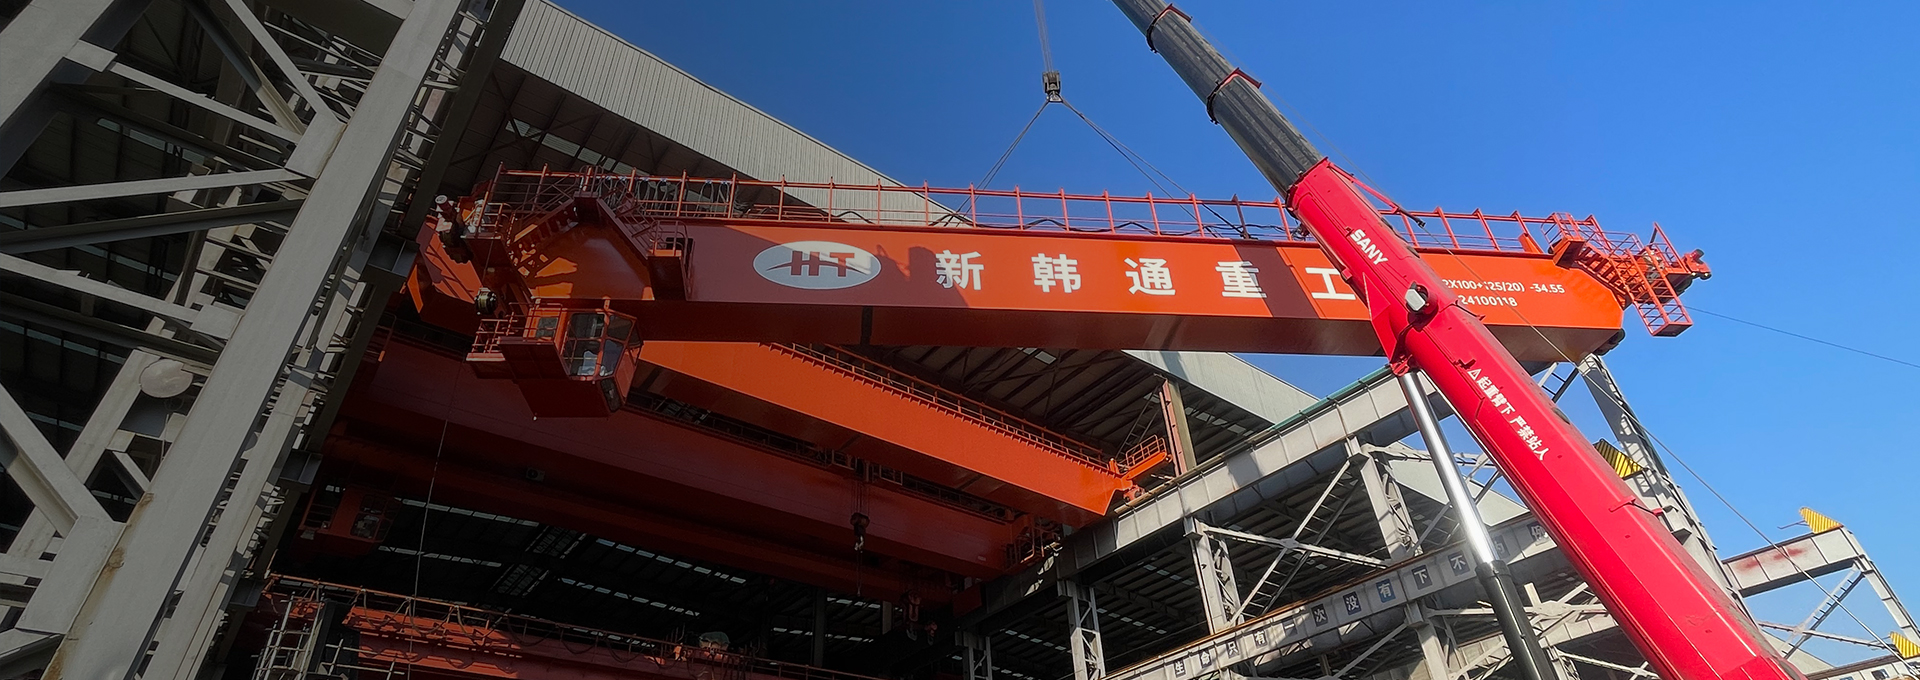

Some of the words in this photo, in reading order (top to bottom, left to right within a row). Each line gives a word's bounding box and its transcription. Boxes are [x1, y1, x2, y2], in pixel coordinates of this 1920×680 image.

[1350, 229, 1388, 265] SANY
[935, 249, 1357, 301] 新韩通重工
[1530, 283, 1566, 294] -34.55
[1457, 294, 1518, 307] 24100118
[1476, 376, 1516, 416] 起重臂下
[1509, 415, 1550, 461] 严禁站人
